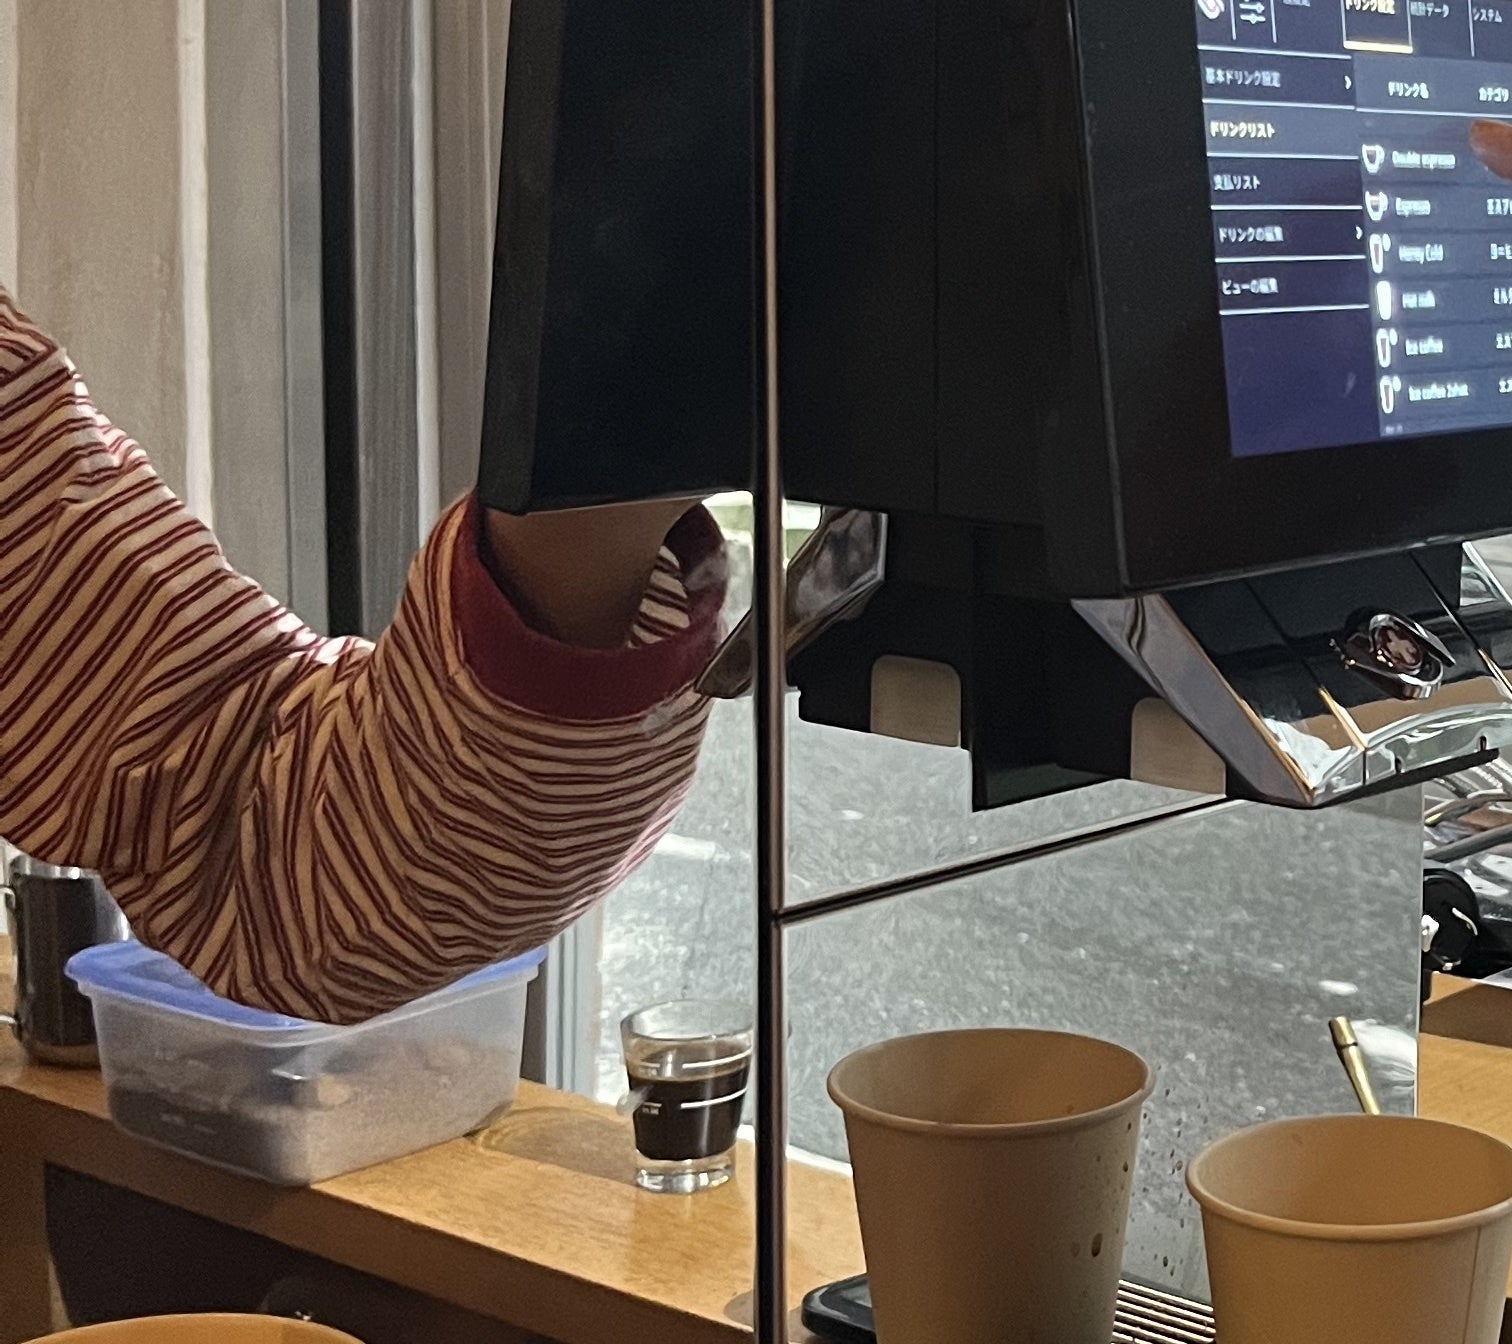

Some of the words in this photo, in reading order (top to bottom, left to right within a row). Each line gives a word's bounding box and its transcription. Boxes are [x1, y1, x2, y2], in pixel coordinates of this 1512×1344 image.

[1472, 8, 1503, 23] システム
[1210, 121, 1276, 139] ドリンクリスト
